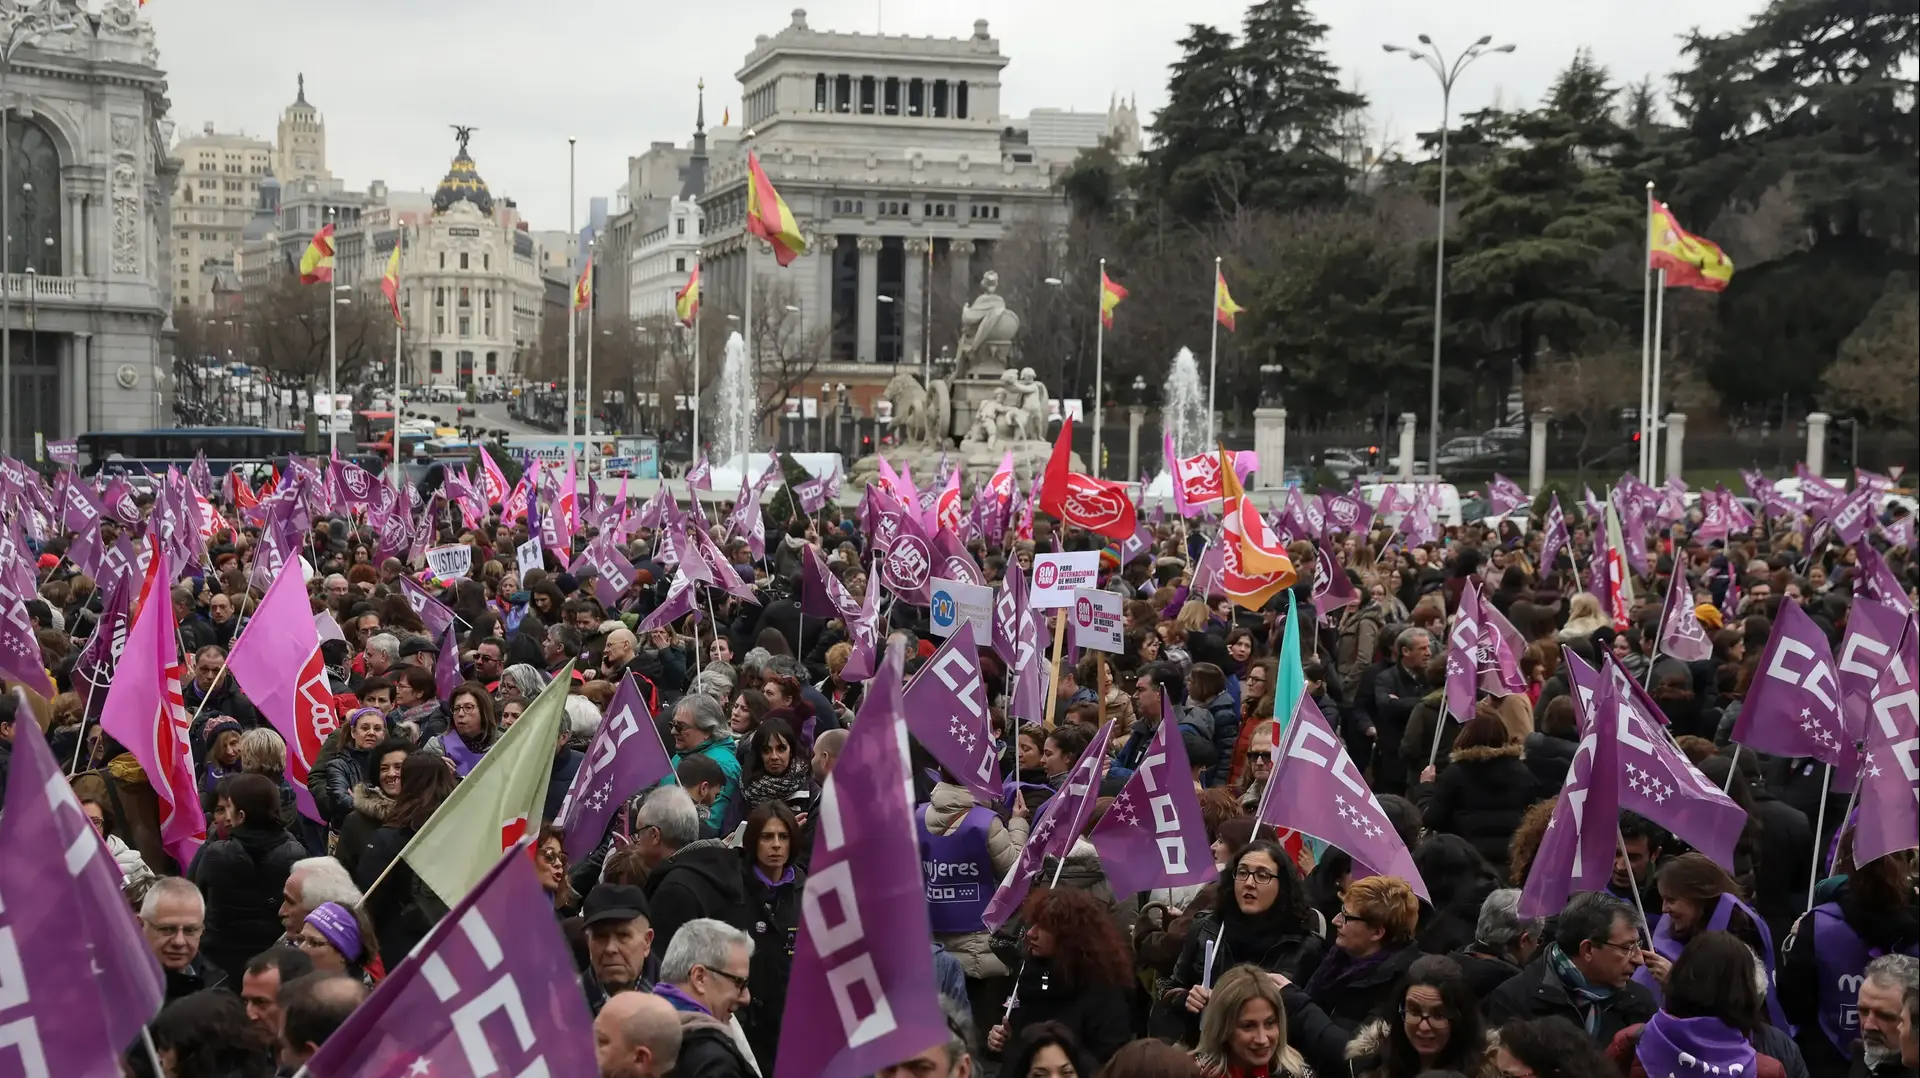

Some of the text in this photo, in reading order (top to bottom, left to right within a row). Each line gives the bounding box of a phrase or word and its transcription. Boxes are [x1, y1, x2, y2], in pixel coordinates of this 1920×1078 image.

[345, 469, 366, 483] UGT
[67, 481, 98, 519] COO
[894, 538, 928, 577] UGT
[1039, 566, 1055, 577] 8M
[1079, 602, 1090, 615] 8M
